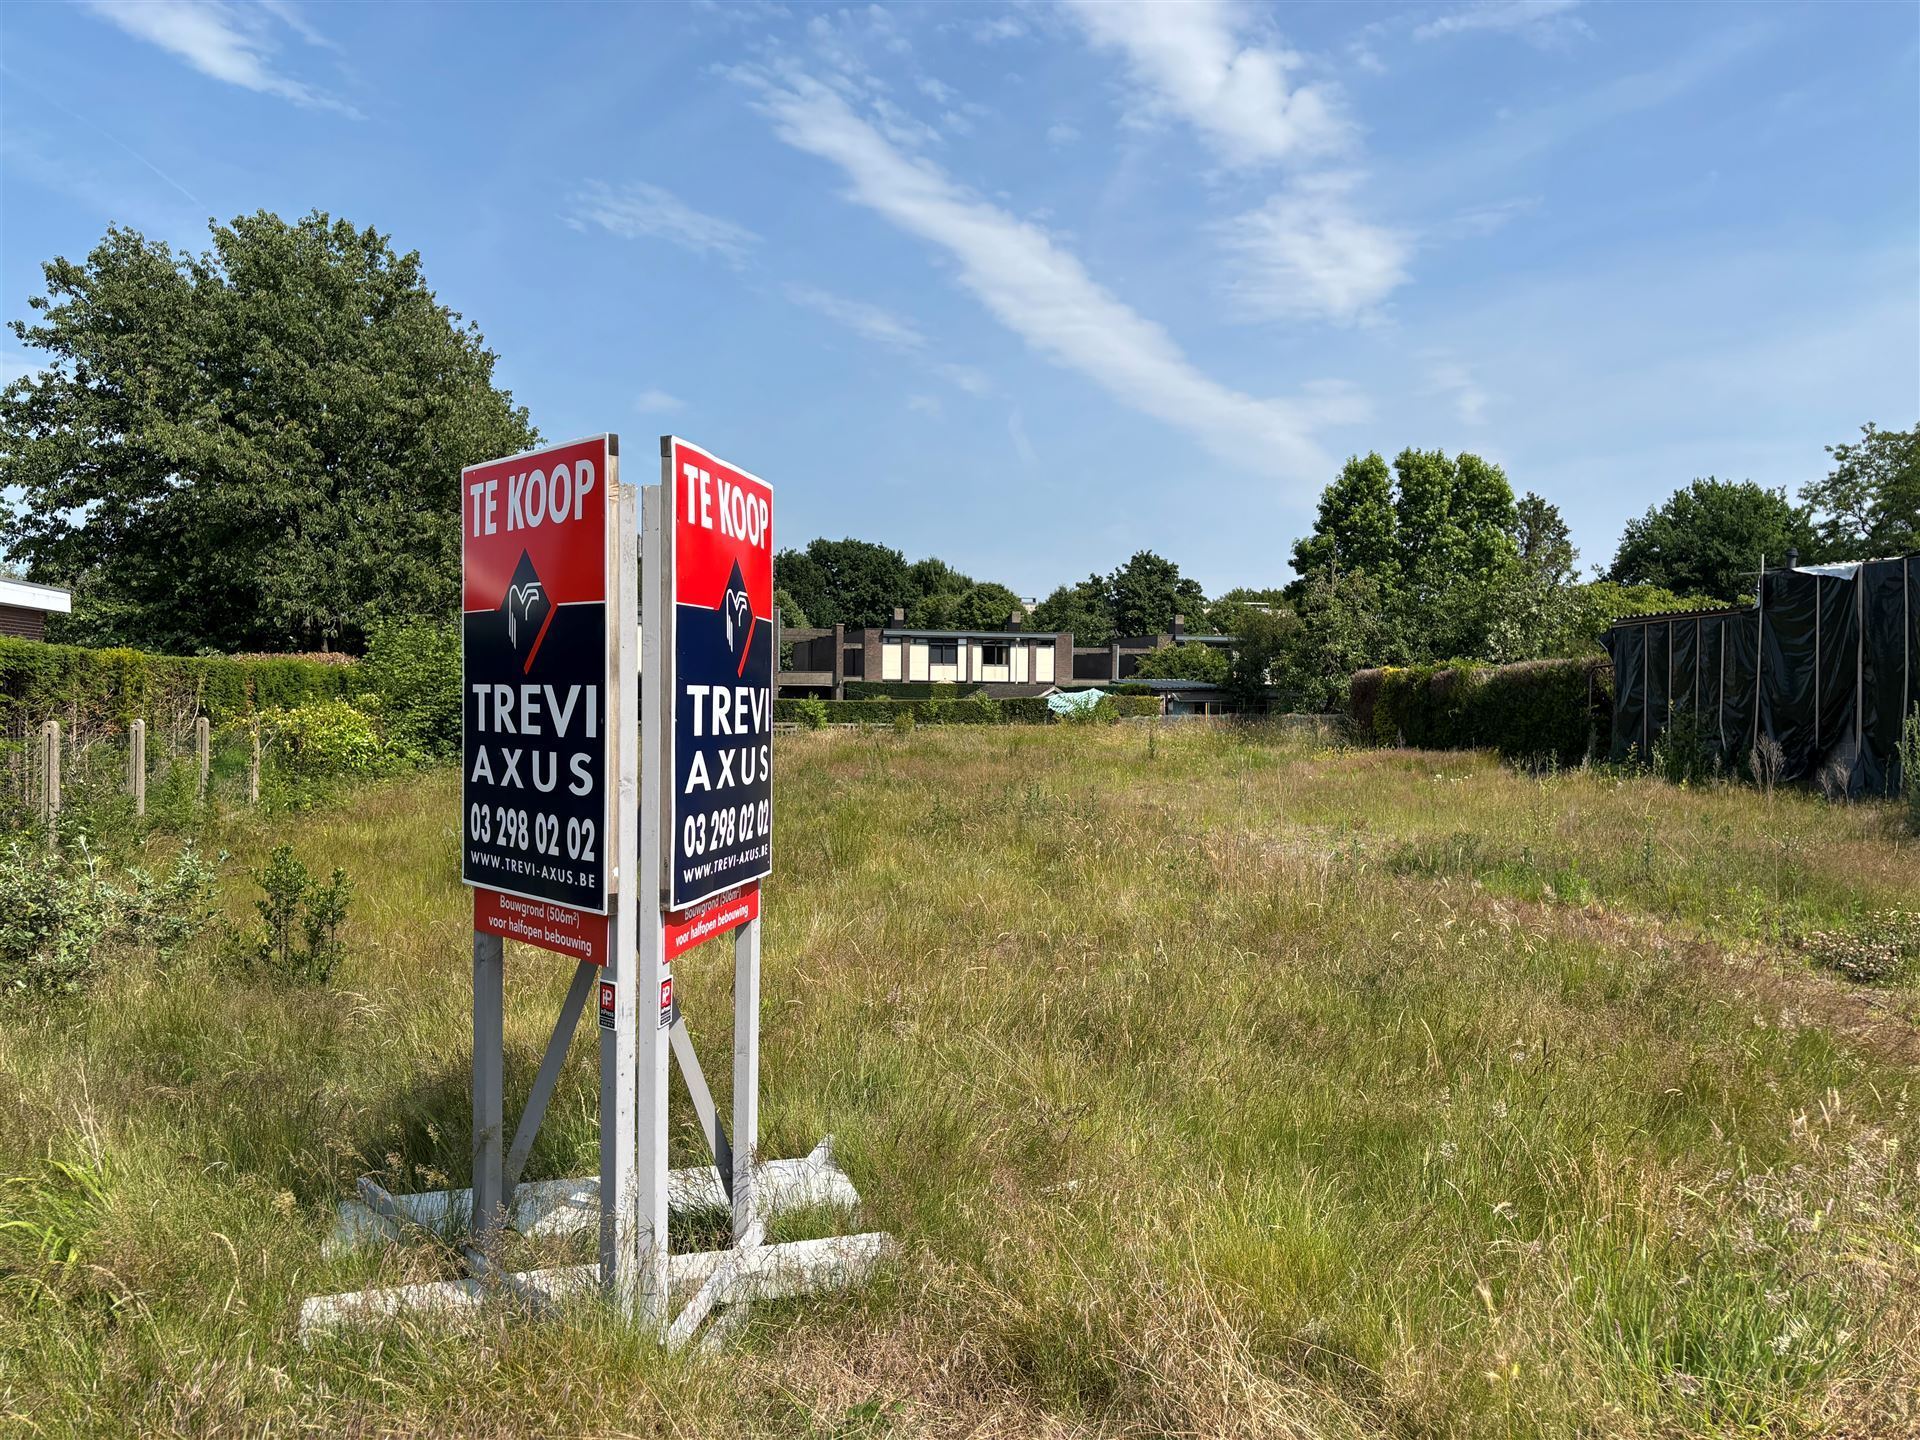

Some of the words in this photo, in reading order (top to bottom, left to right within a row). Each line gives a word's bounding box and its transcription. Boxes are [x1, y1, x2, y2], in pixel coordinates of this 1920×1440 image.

[470, 479, 498, 538] TE
[507, 459, 596, 532] KOOP
[683, 462, 713, 530] TE
[716, 476, 769, 549] KOOP
[472, 684, 597, 738] TREVI
[686, 684, 770, 737] TREVI
[471, 745, 594, 796] AXUS
[684, 744, 769, 794] AXUS
[470, 802, 491, 843] 03
[496, 806, 529, 851] 298
[535, 812, 560, 856] 02
[566, 816, 595, 862] 02
[684, 813, 706, 858] 03
[709, 806, 736, 851] 298
[738, 802, 755, 843] 02
[757, 798, 769, 837] 02
[470, 850, 595, 888] WWW.TREVI-AXUS.BE
[683, 843, 768, 884] WWW.TREVI-AXUS.BE
[499, 894, 545, 918] Bouwgrond
[546, 906, 580, 929] (506m²)
[675, 931, 689, 947] voor
[690, 920, 717, 940] halfopen
[717, 904, 749, 926] bebouwing
[684, 899, 719, 921] Bouwgrond
[488, 916, 506, 929] voor
[508, 916, 542, 940] halfopen
[544, 926, 592, 957] bebouwing
